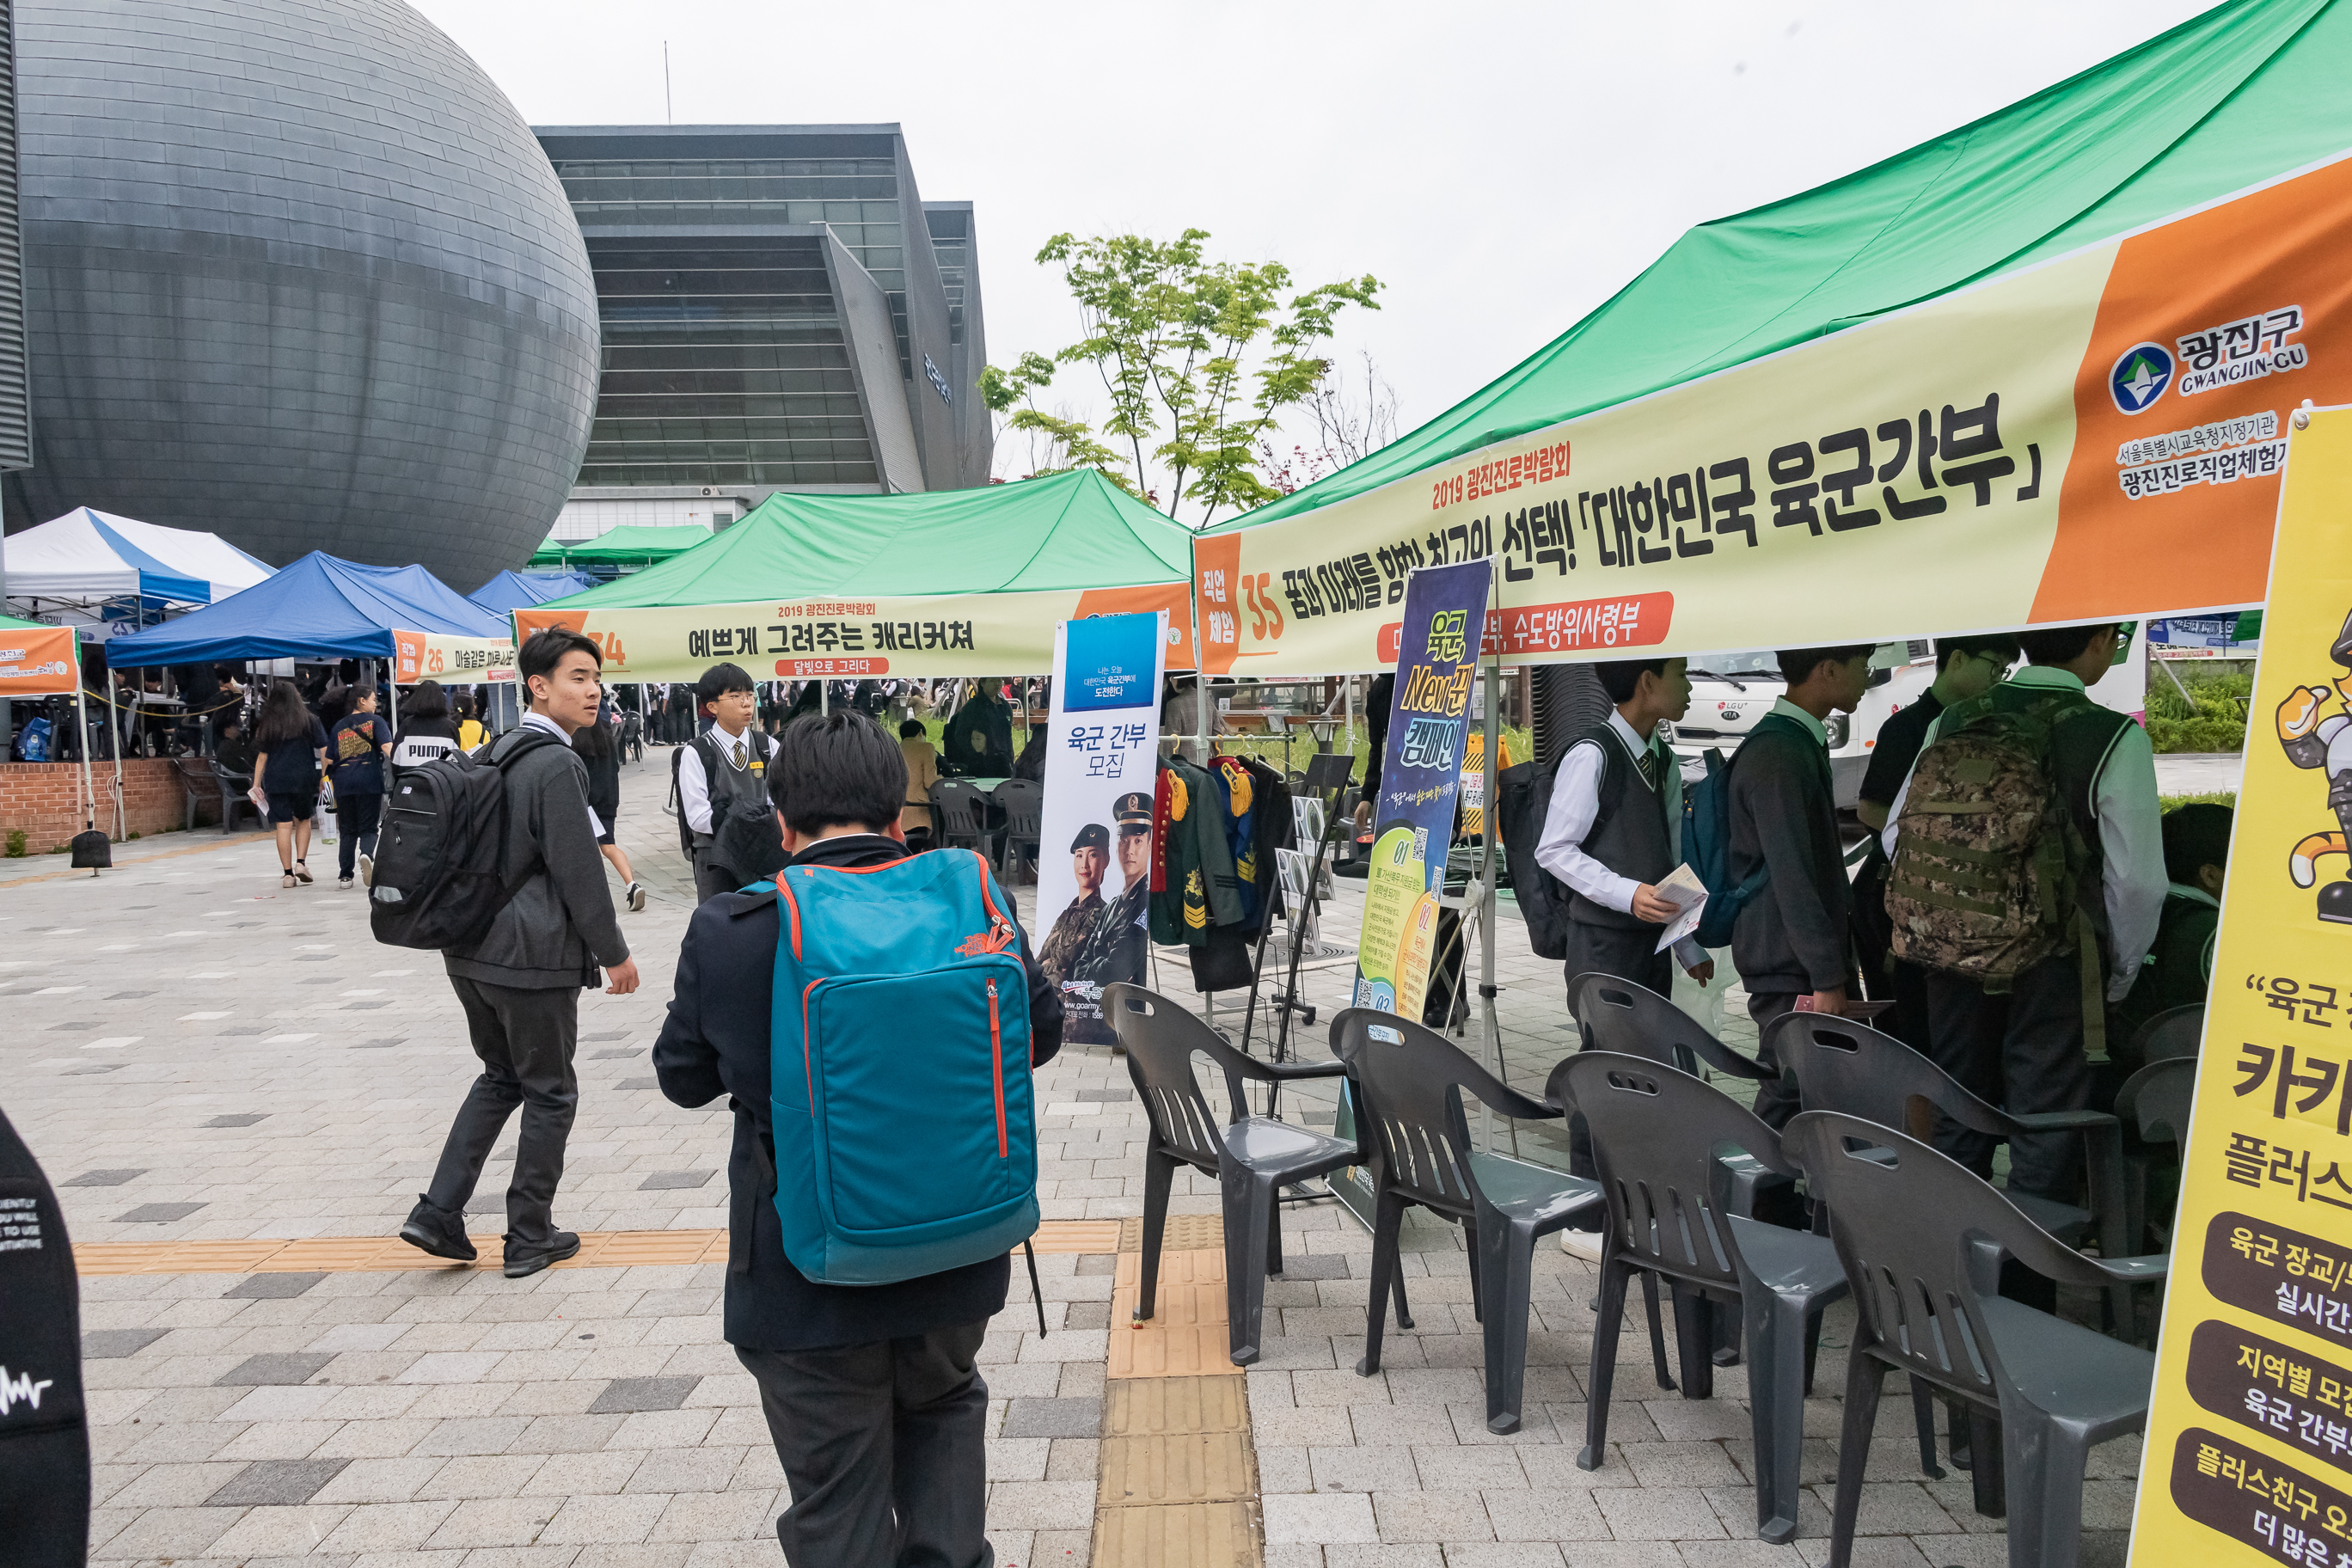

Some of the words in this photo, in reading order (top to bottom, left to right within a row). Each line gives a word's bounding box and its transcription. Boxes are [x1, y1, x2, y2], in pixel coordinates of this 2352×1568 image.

[2180, 310, 2299, 371] 광진구
[2182, 347, 2305, 393] GWANGJIN-GU
[2119, 415, 2275, 462] 서울특별시교육청지정기관
[1432, 475, 1463, 510] 2019
[1467, 440, 1571, 500] 광진진로박람회
[1283, 567, 1326, 619] 꿈과
[1317, 553, 1381, 613] 미래를
[1503, 499, 1577, 582] 선택!
[1204, 569, 1226, 602] 직업
[777, 606, 803, 618] 2019
[805, 603, 876, 616] 광진진로박람회
[1209, 610, 1234, 643] 체험
[1242, 573, 1283, 640] 35
[1513, 601, 1641, 651] 수도방위사령부
[689, 625, 758, 658] 예쁘게
[767, 621, 865, 654] 그려주는
[872, 621, 975, 652] 캐리커쳐
[428, 649, 444, 672] 26
[793, 660, 834, 674] 달빛으로
[838, 659, 871, 673] 그리다
[1084, 677, 1106, 686] 대한민국
[1107, 674, 1136, 684] 육군간부에
[1098, 666, 1109, 675] 나는
[1111, 665, 1122, 674] 오늘
[1094, 686, 1124, 697] 도전한다
[1068, 726, 1104, 752] 육군
[1110, 723, 1146, 750] 간부
[1400, 717, 1461, 772] 캠페인
[1086, 753, 1125, 778] 모집
[1393, 840, 1410, 867] 01
[1419, 903, 1430, 931] 02
[965, 934, 982, 943] THE
[2245, 974, 2338, 1027] “육군
[2230, 1227, 2279, 1267] 육군
[2275, 1281, 2352, 1334] 실시간
[2237, 1344, 2312, 1399] 지역별
[2244, 1387, 2293, 1432] 육군
[2298, 1410, 2352, 1456] 간부
[2196, 1442, 2318, 1522] 플러스친구
[2321, 1505, 2352, 1542] 오
[2253, 1510, 2277, 1547] 더
[2282, 1522, 2329, 1568] 많은
